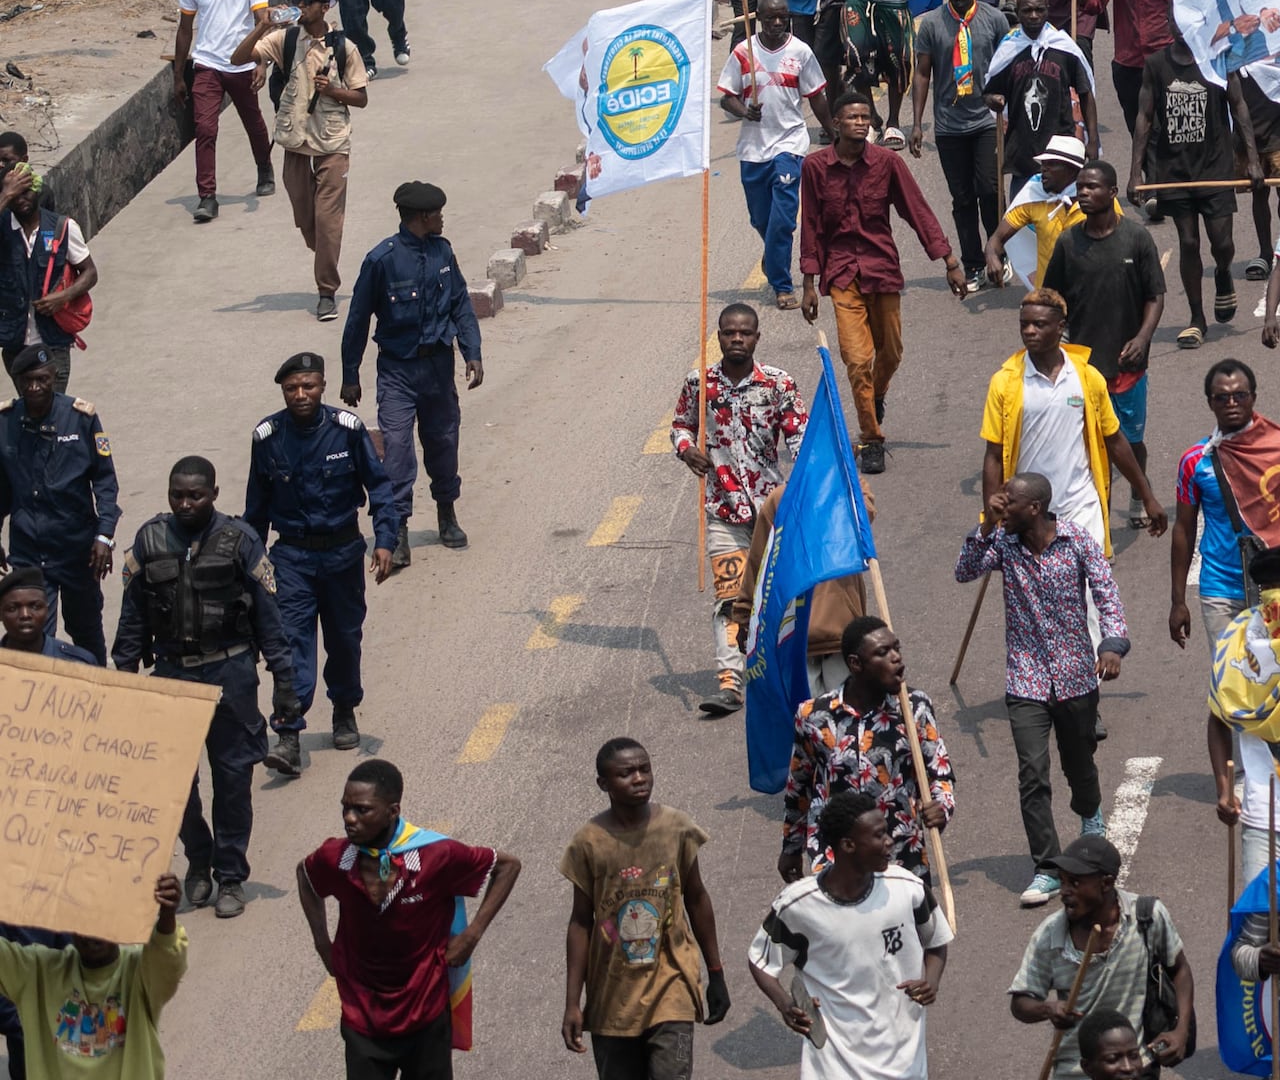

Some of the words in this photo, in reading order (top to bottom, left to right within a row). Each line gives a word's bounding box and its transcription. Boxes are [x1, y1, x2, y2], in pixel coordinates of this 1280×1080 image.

[1166, 92, 1189, 109] KEEP
[1189, 92, 1208, 101] THE
[1166, 100, 1208, 118] LONELY
[1167, 116, 1207, 134] PLACES
[1168, 127, 1206, 144] LONELY
[57, 434, 80, 443] POLICE
[326, 451, 349, 462] POLICE
[82, 733, 159, 761] CHAQUE
[84, 772, 121, 795] UNE
[24, 789, 57, 810] ET
[56, 797, 89, 818] UNE
[1240, 979, 1258, 1035] pour
[1250, 1033, 1262, 1059] le
